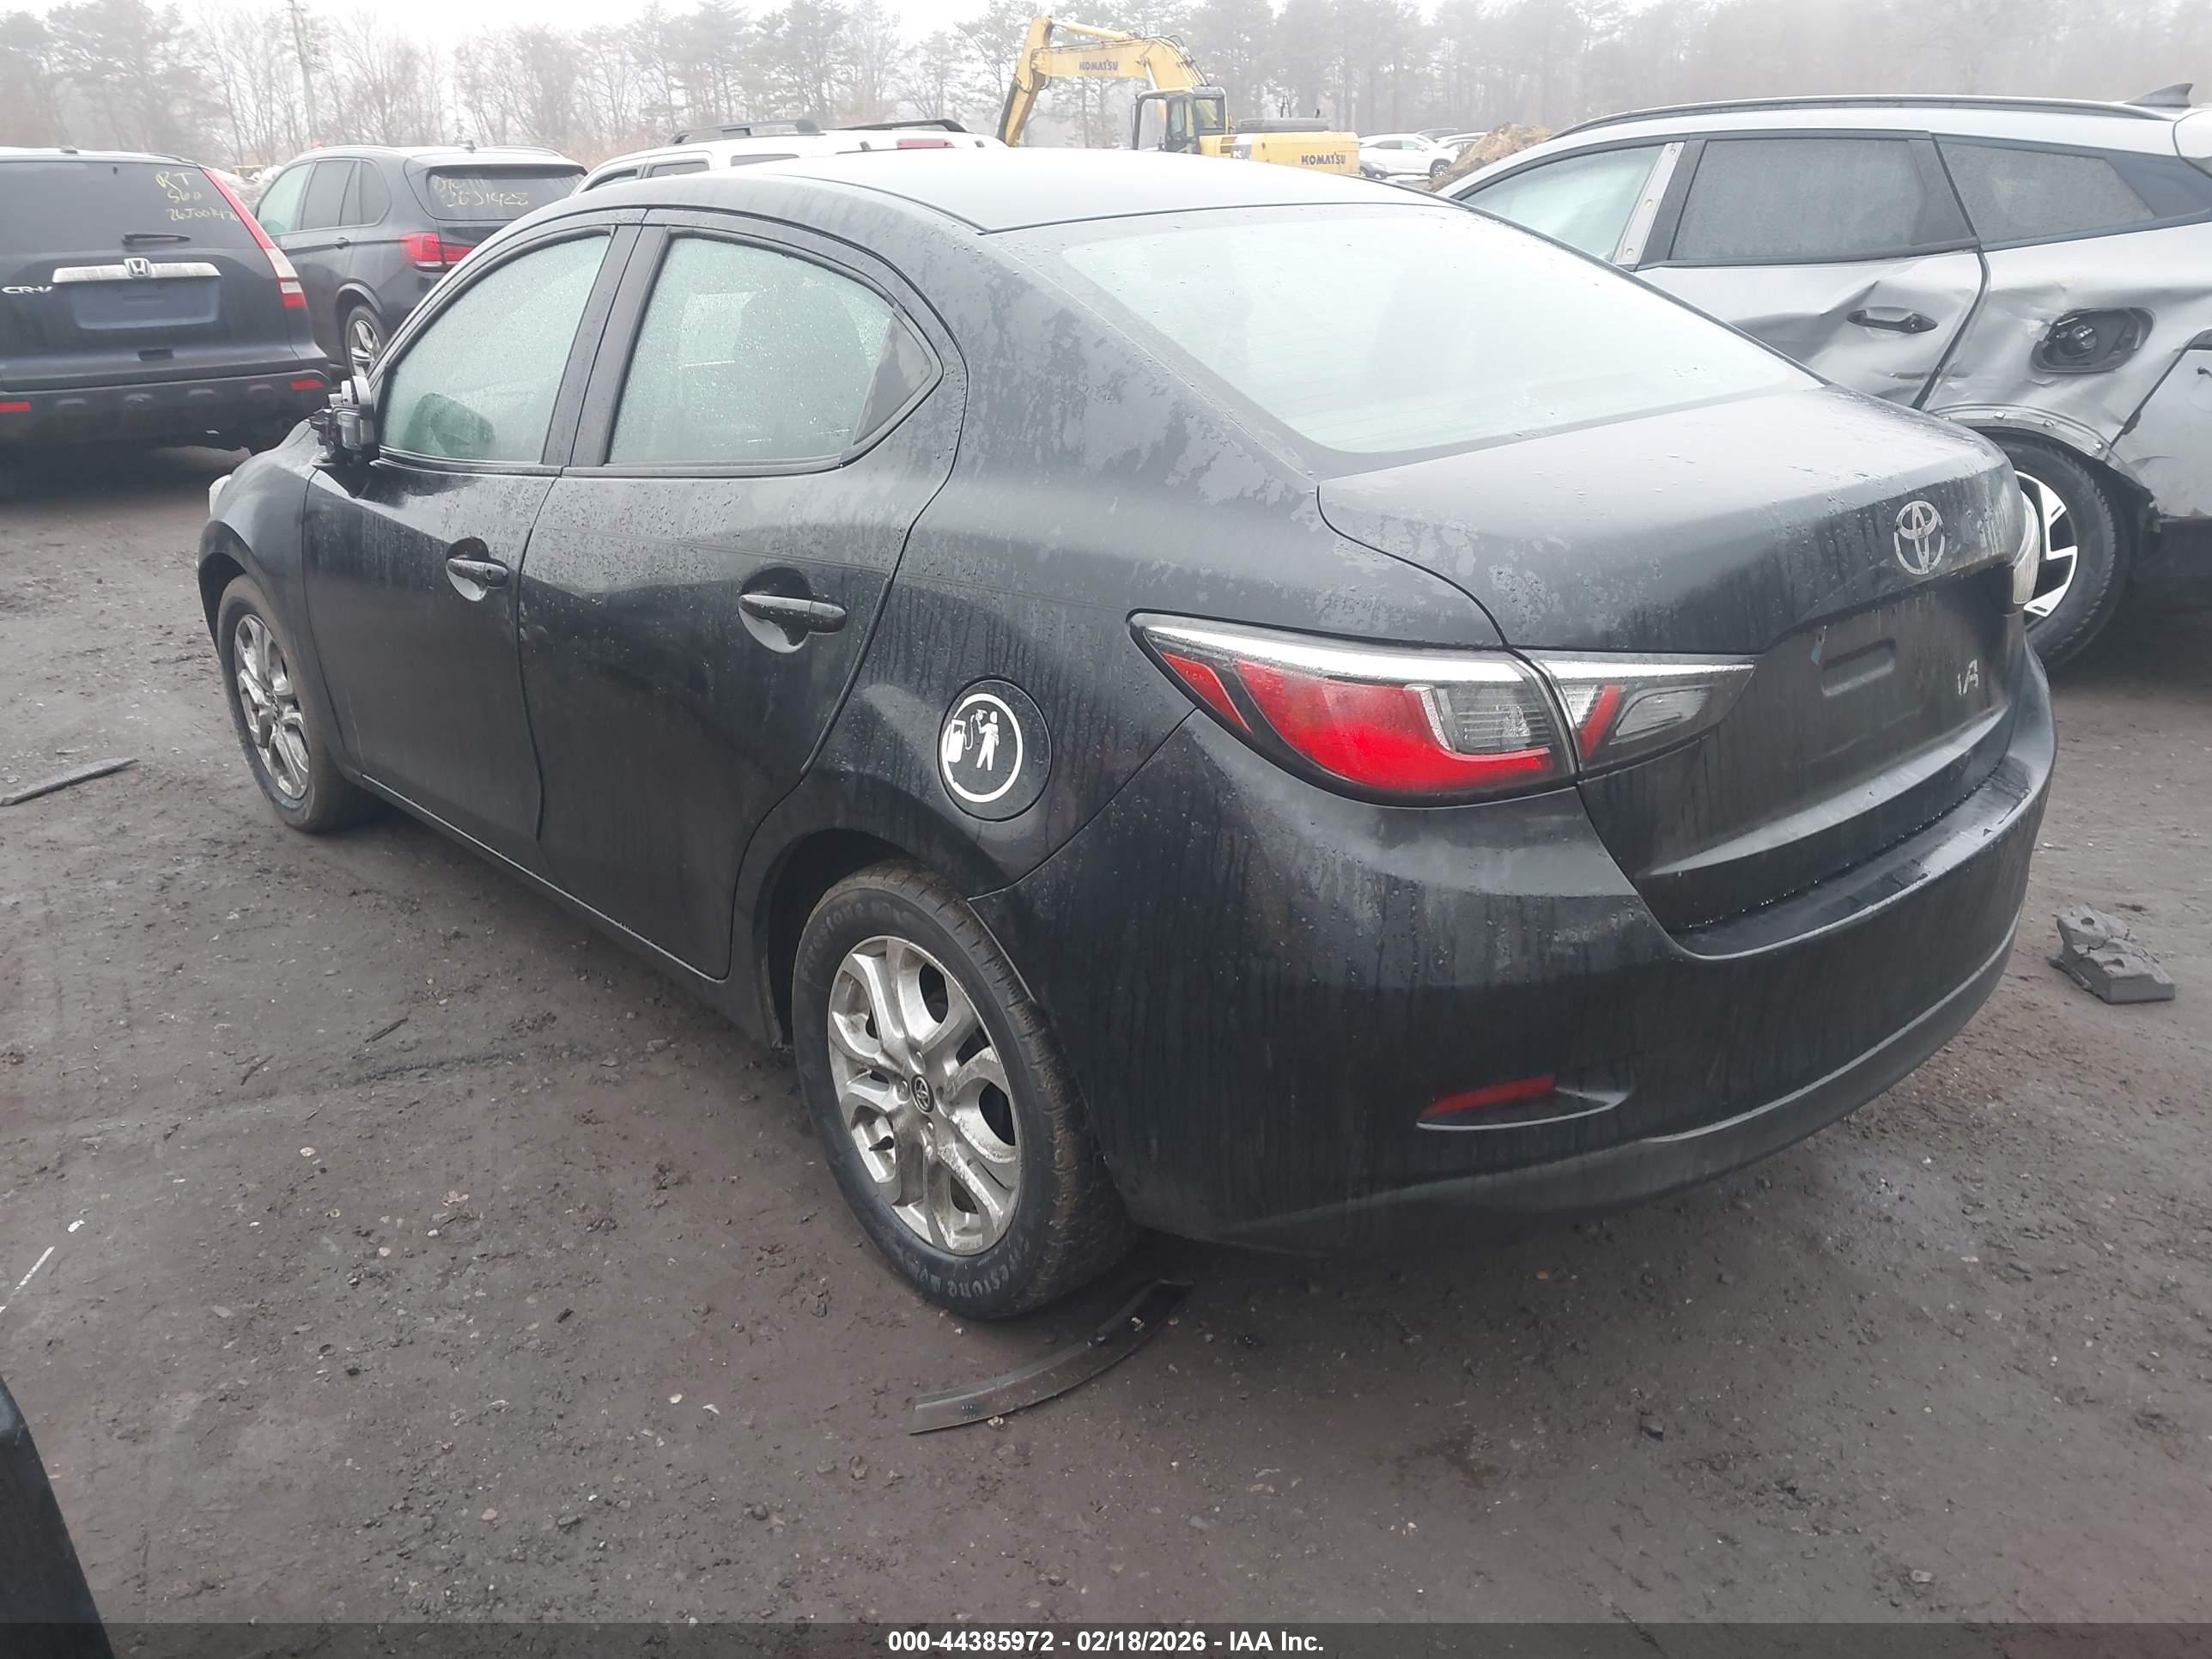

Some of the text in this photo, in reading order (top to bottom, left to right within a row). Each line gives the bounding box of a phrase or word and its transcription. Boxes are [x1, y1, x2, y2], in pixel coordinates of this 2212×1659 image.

[1079, 59, 1119, 71] KOMATSU
[1301, 152, 1346, 166] KOMATSU
[1, 285, 53, 295] CR-V
